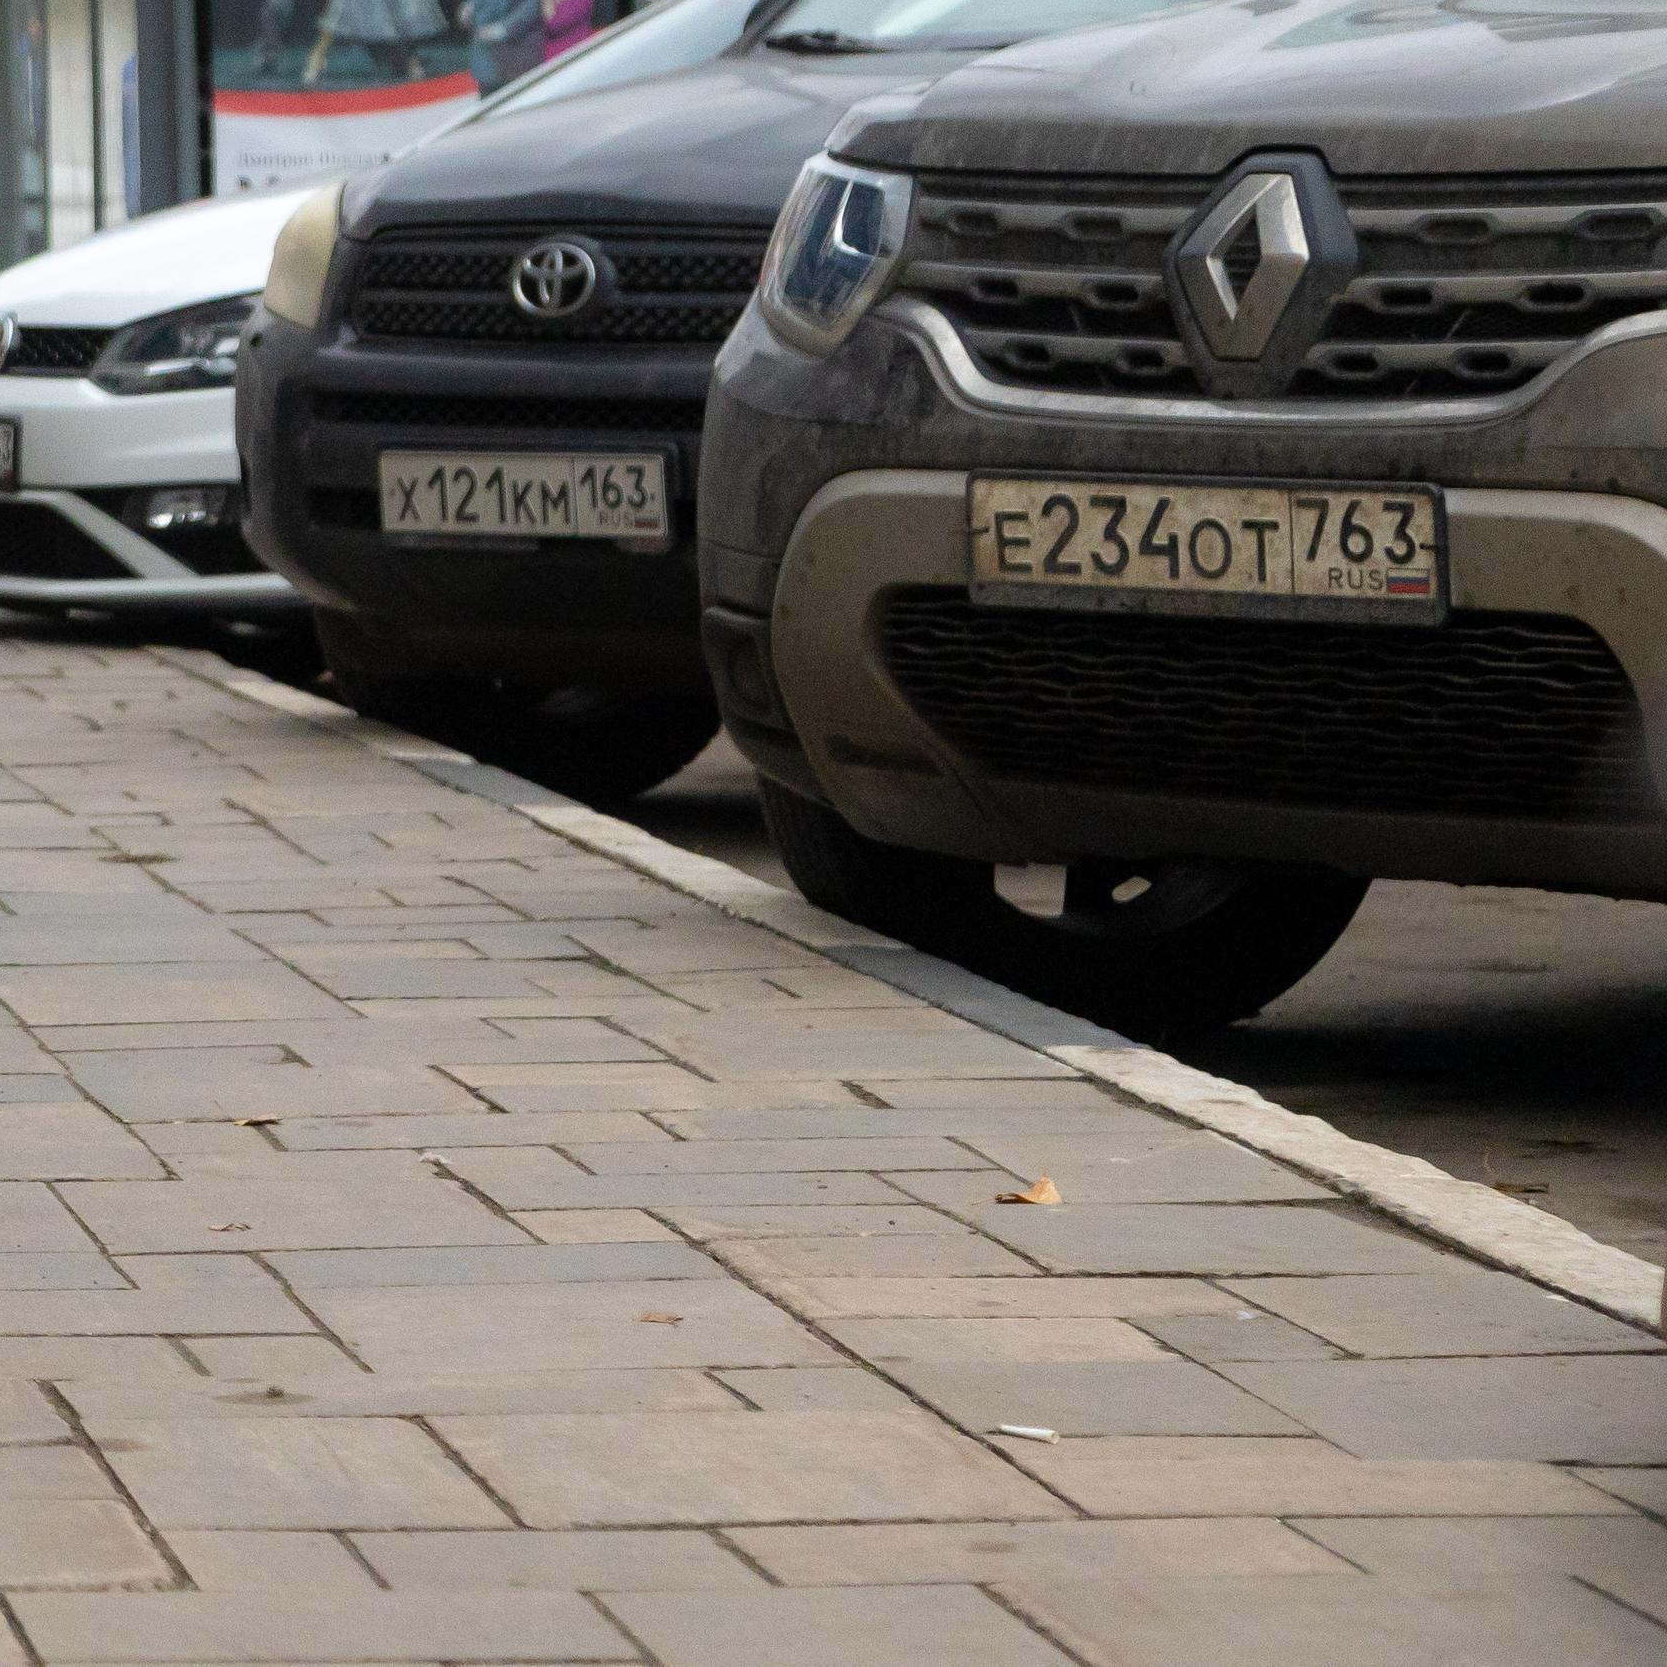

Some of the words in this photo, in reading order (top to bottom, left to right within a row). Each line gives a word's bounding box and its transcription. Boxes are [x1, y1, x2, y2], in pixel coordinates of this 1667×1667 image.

[579, 465, 648, 510] 163
[993, 494, 1280, 584] Е234ОТ
[1295, 496, 1417, 565] 763
[1327, 567, 1384, 591] RUS
